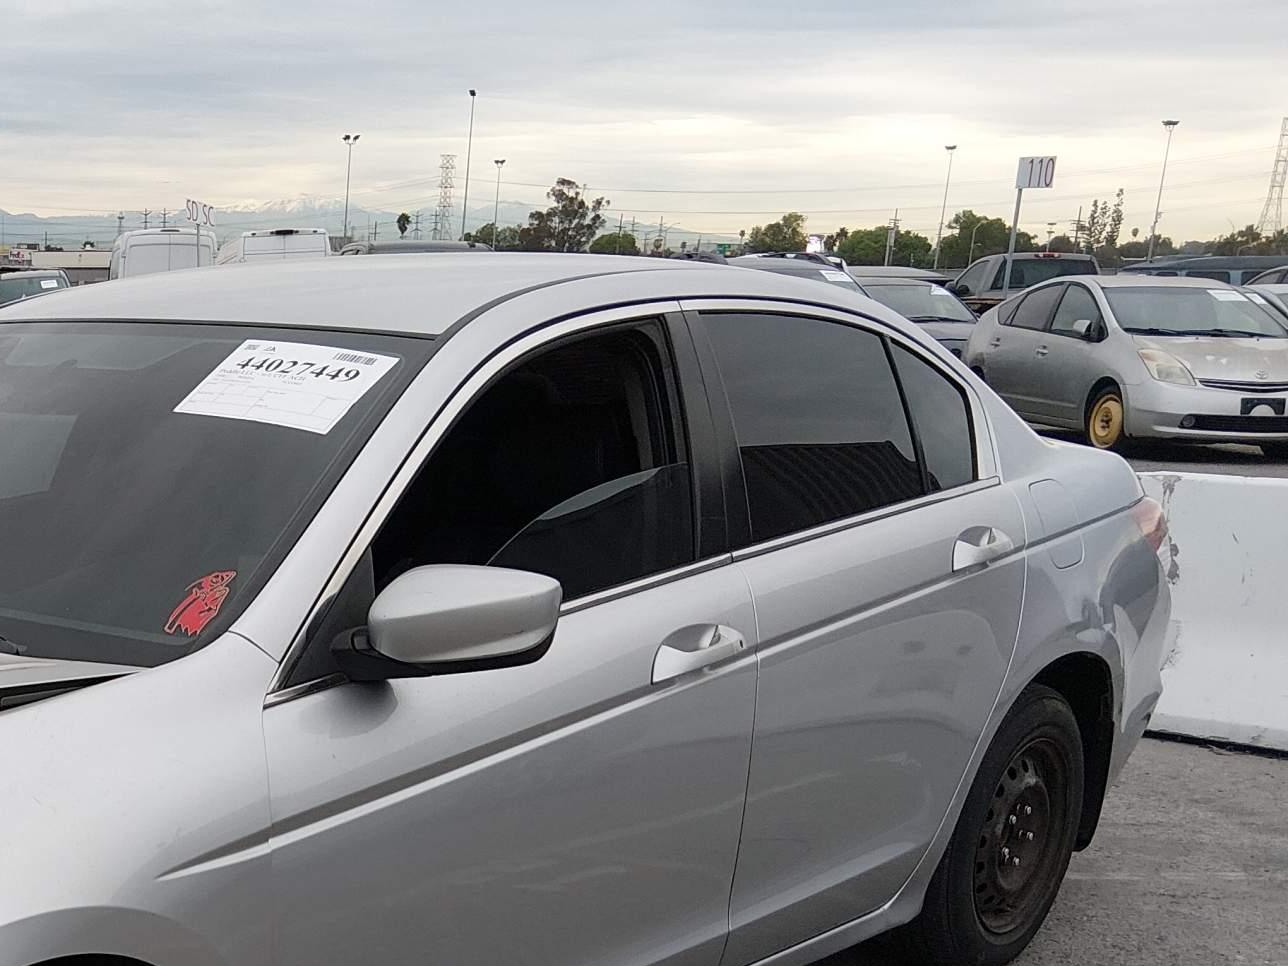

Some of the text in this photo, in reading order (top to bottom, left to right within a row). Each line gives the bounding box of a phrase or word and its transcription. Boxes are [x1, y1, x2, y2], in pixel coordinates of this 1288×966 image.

[1028, 158, 1055, 188] 110
[186, 199, 215, 227] SD SC
[236, 356, 361, 383] 44027449
